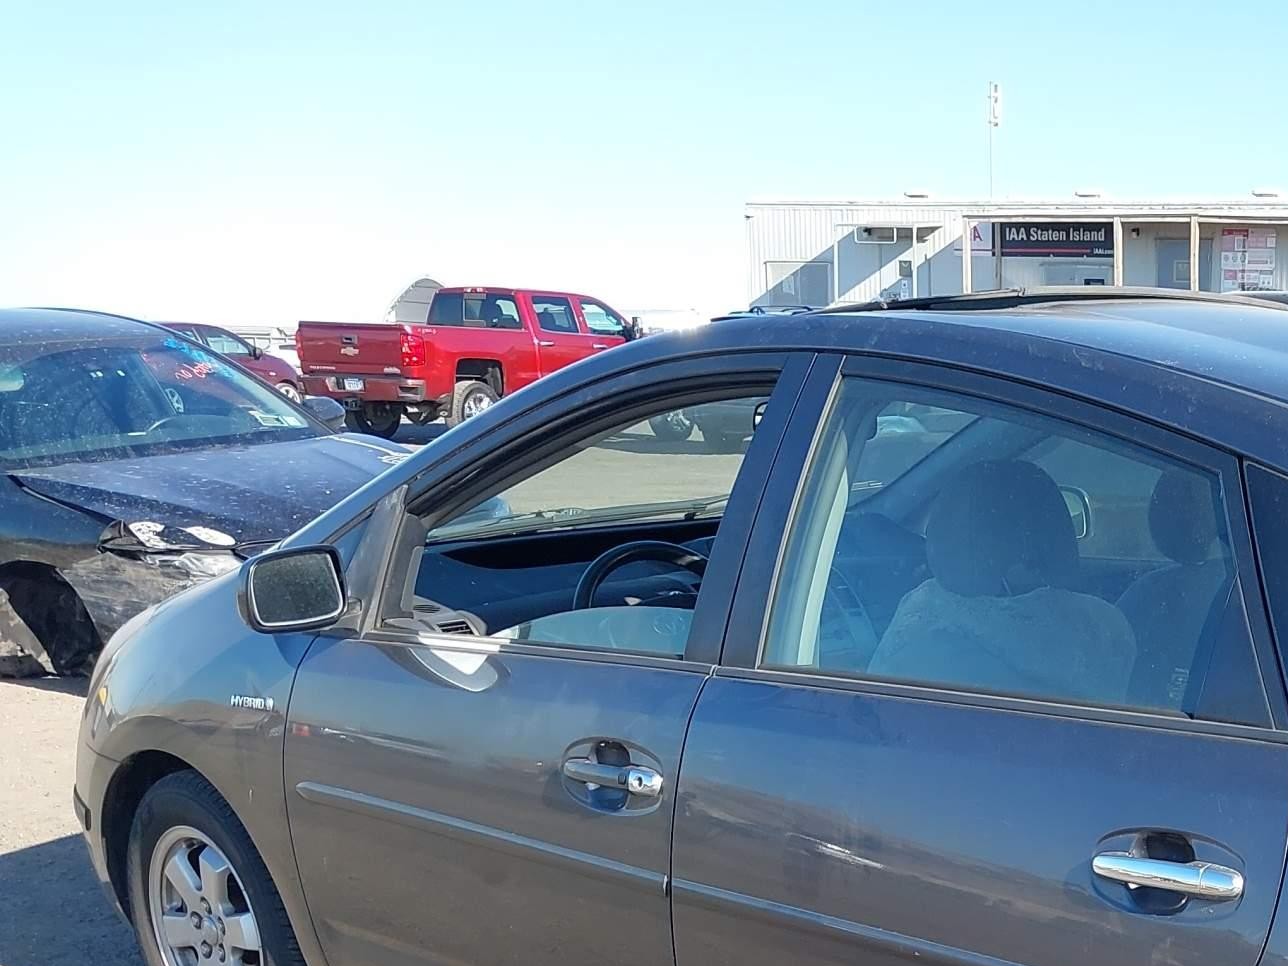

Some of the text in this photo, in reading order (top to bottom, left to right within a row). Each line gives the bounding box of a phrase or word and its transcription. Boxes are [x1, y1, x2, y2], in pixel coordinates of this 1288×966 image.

[1005, 227, 1105, 241] IAA Staten Island
[230, 695, 265, 710] HYBRID
